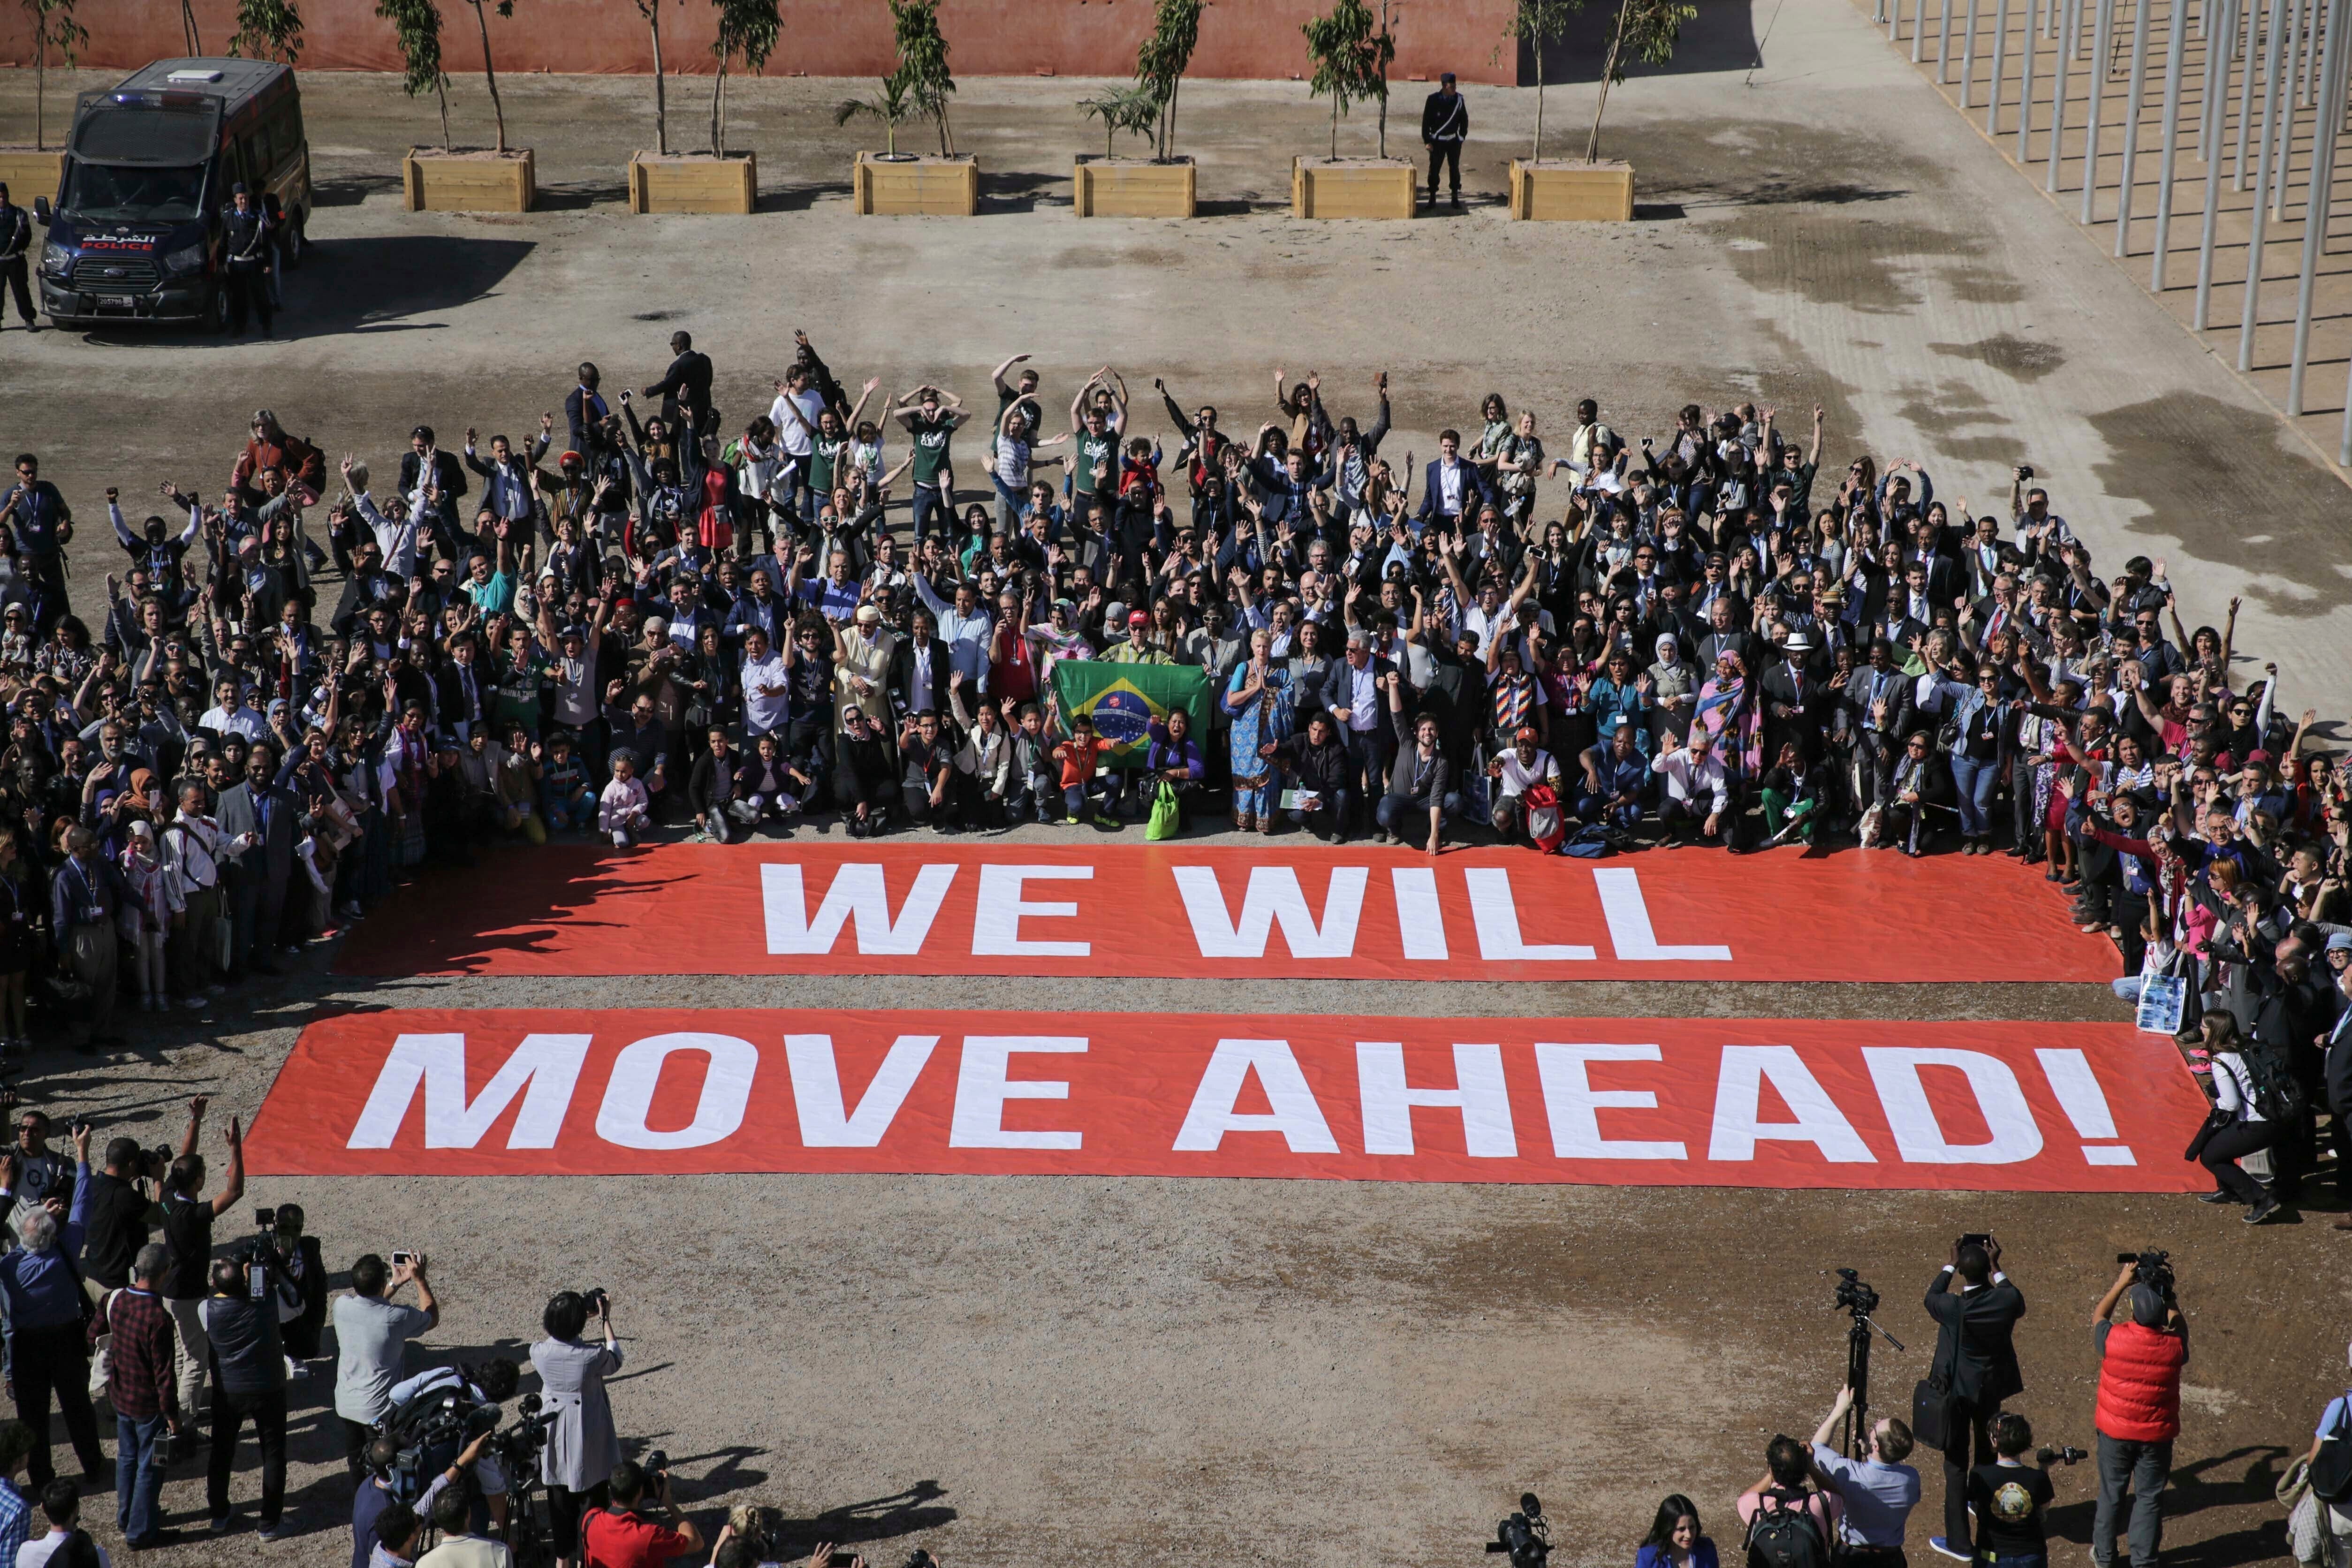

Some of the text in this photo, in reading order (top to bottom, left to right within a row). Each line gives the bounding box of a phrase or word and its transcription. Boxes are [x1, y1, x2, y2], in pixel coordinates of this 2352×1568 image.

[83, 234, 155, 242] الشرطة
[760, 863, 1733, 961] WE WILL
[346, 1032, 2138, 1167] MOVE AHEAD!
